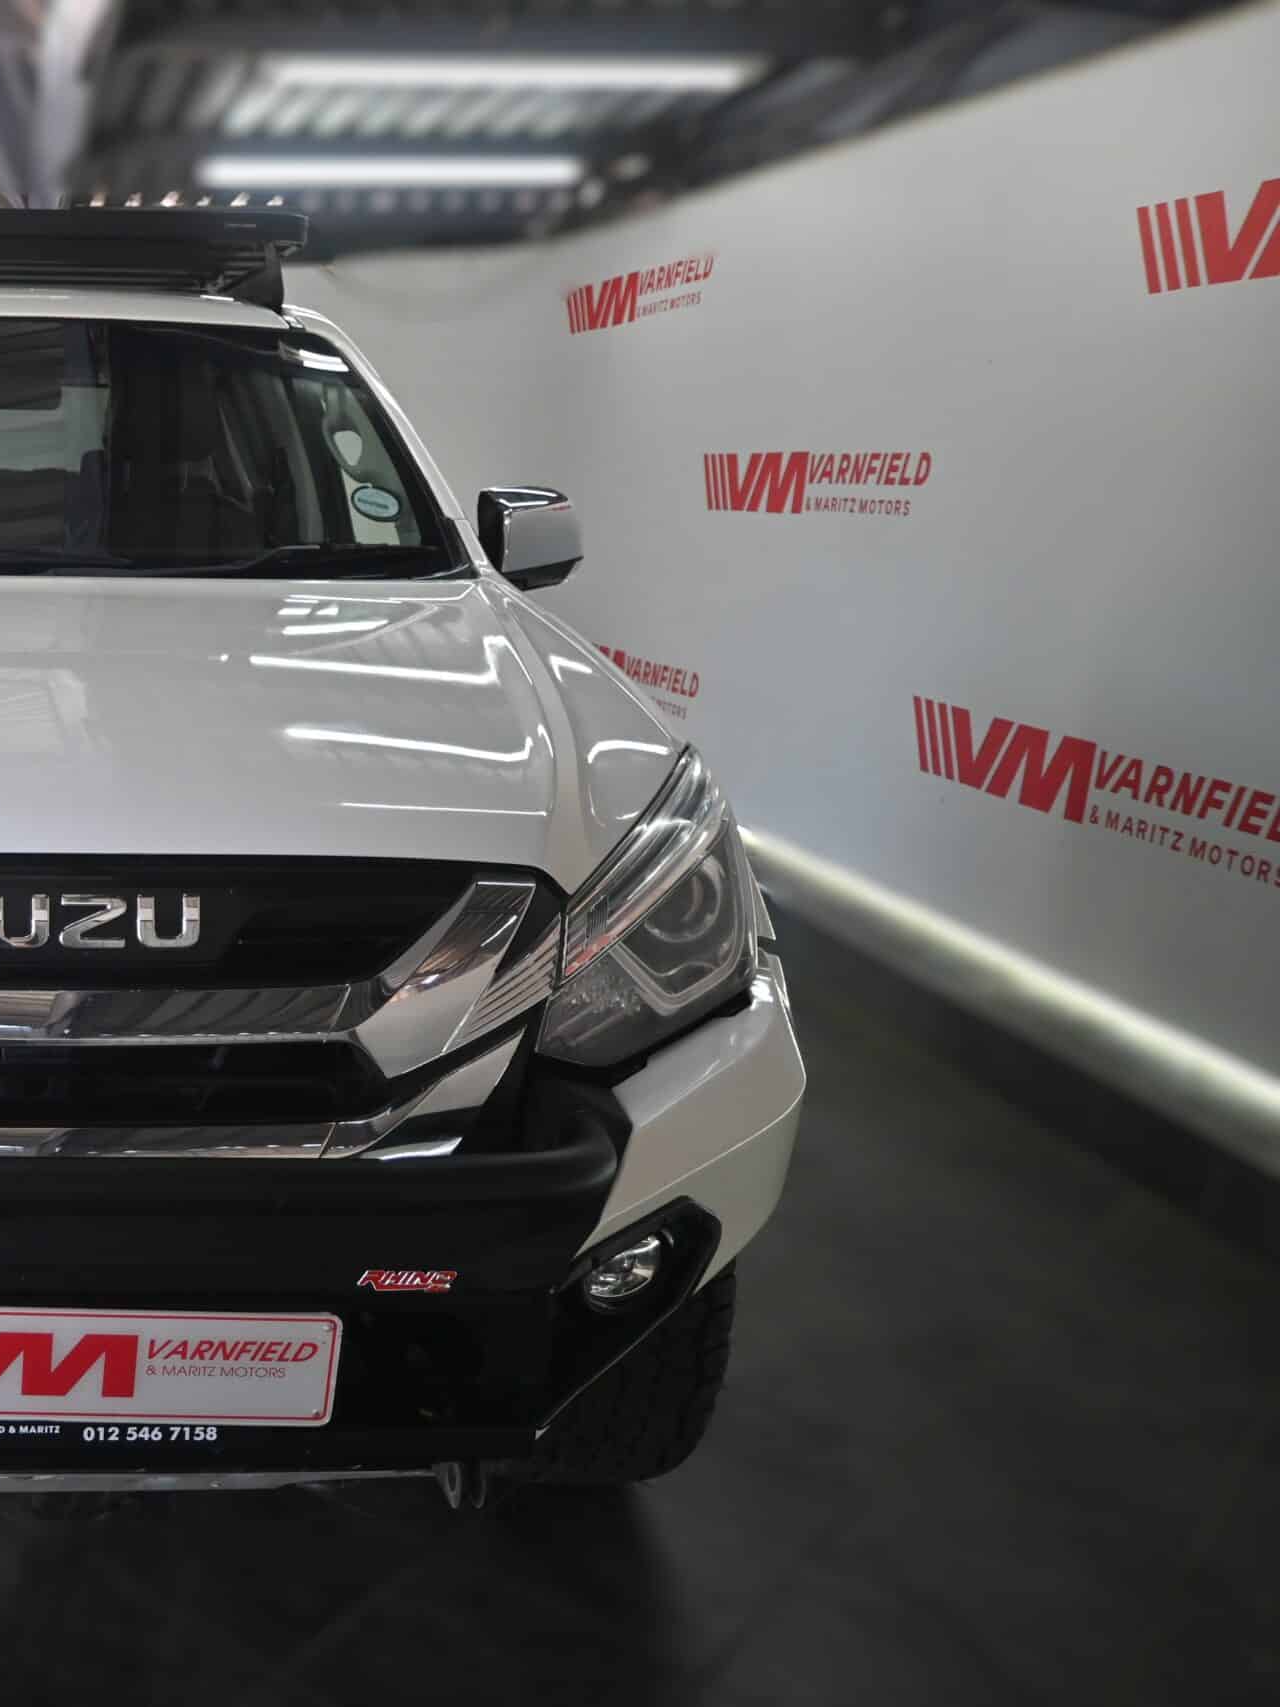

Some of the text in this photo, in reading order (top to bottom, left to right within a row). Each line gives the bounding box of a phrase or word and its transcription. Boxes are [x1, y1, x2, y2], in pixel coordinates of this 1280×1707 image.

[639, 255, 714, 296] VARNFIELD
[726, 451, 810, 514] VM
[808, 452, 932, 486] VARNFIELD
[814, 497, 857, 514] MARITZ
[858, 499, 911, 517] MOTORS
[951, 705, 1097, 824] VM
[1089, 805, 1099, 825] &
[1104, 809, 1185, 852] MARITZ
[147, 1338, 320, 1364] VARNFIELD
[145, 1364, 287, 1379] & MARITZ MOTORS
[9, 1426, 17, 1435] &
[20, 1425, 61, 1435] MARITZ
[83, 1426, 218, 1441] 012 546 7158
